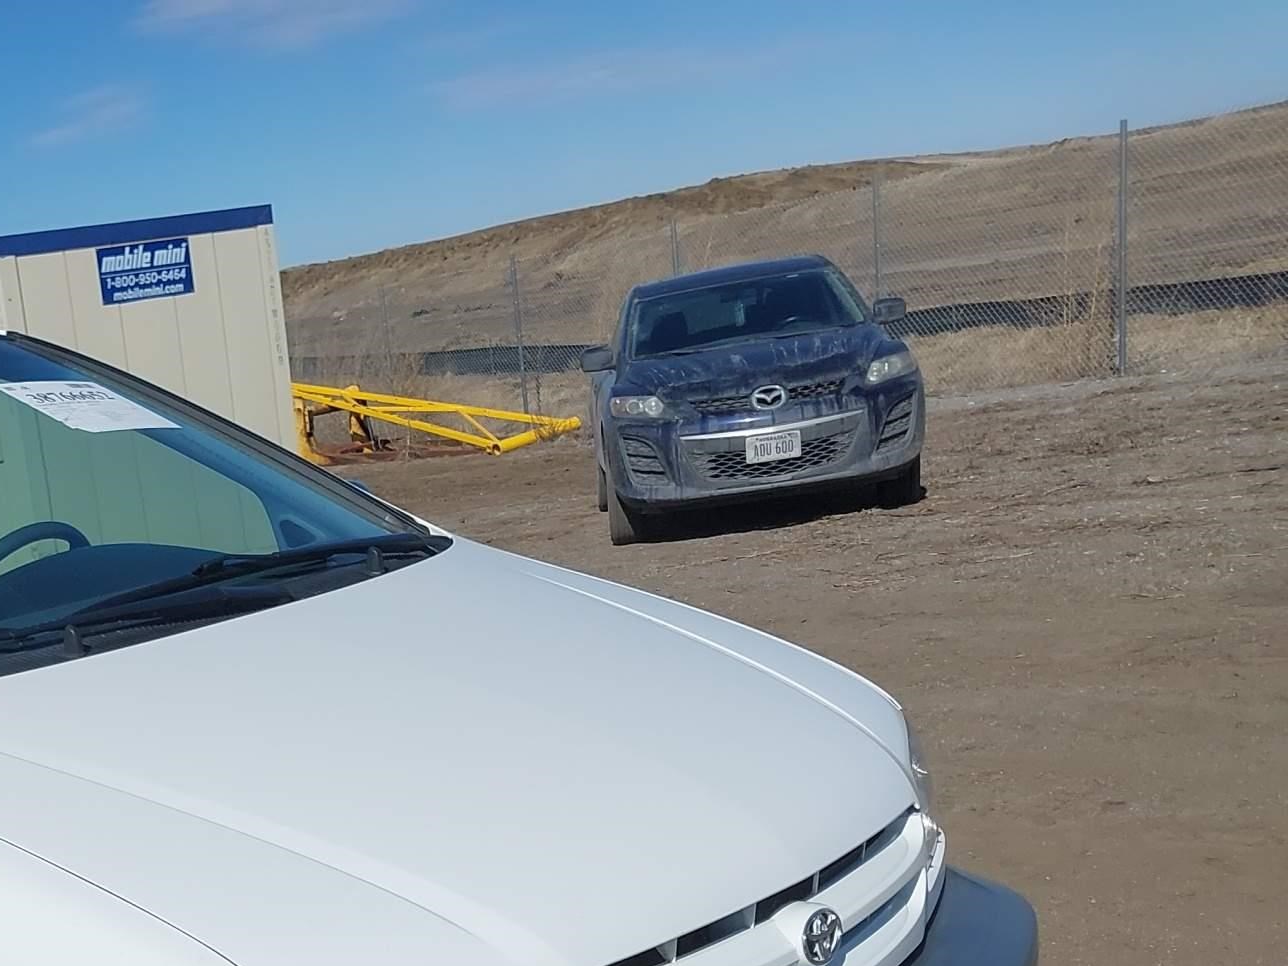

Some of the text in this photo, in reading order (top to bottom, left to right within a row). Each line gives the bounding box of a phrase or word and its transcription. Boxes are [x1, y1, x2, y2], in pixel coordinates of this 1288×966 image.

[101, 242, 187, 273] mobile mini
[113, 283, 184, 301] mobilemini.com
[25, 390, 116, 404] 38766652
